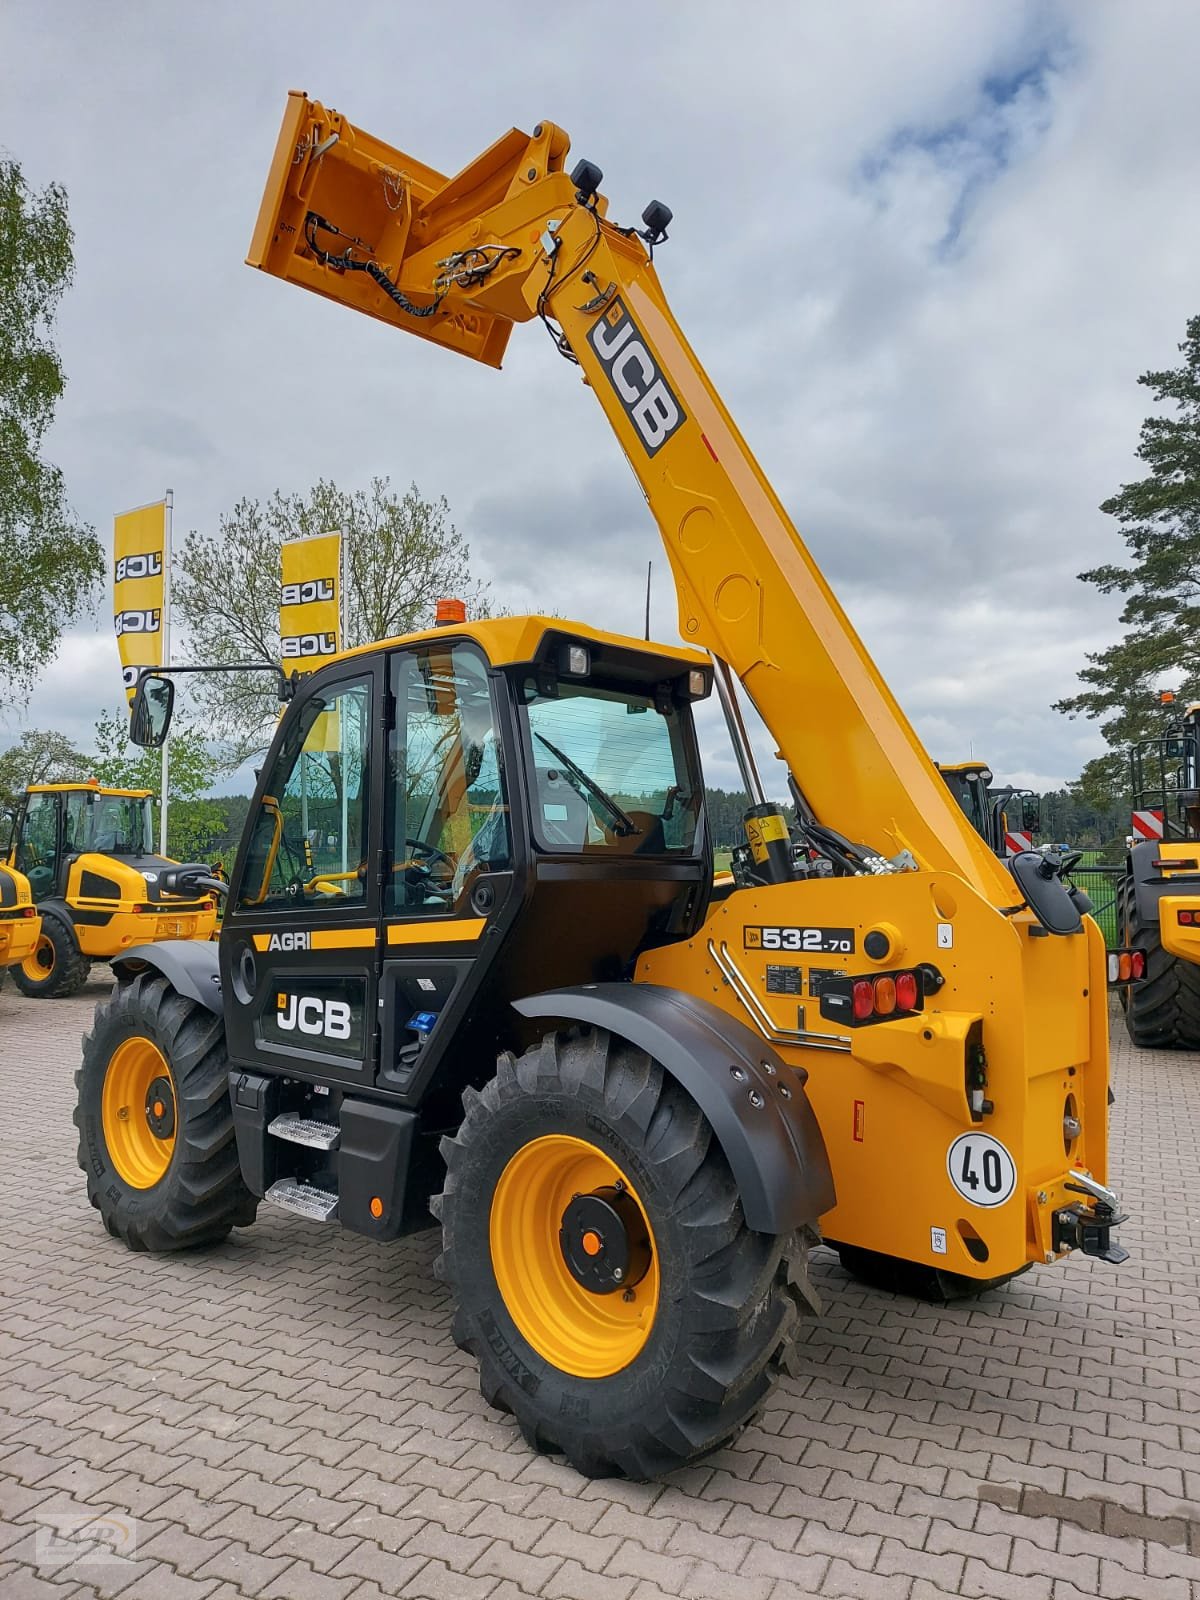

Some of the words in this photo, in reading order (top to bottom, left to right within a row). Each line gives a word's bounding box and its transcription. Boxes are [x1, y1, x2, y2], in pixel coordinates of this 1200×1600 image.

[593, 320, 679, 448] JCB
[269, 932, 311, 952] AGRI
[277, 995, 351, 1040] JCB
[961, 1146, 1002, 1193] 40
